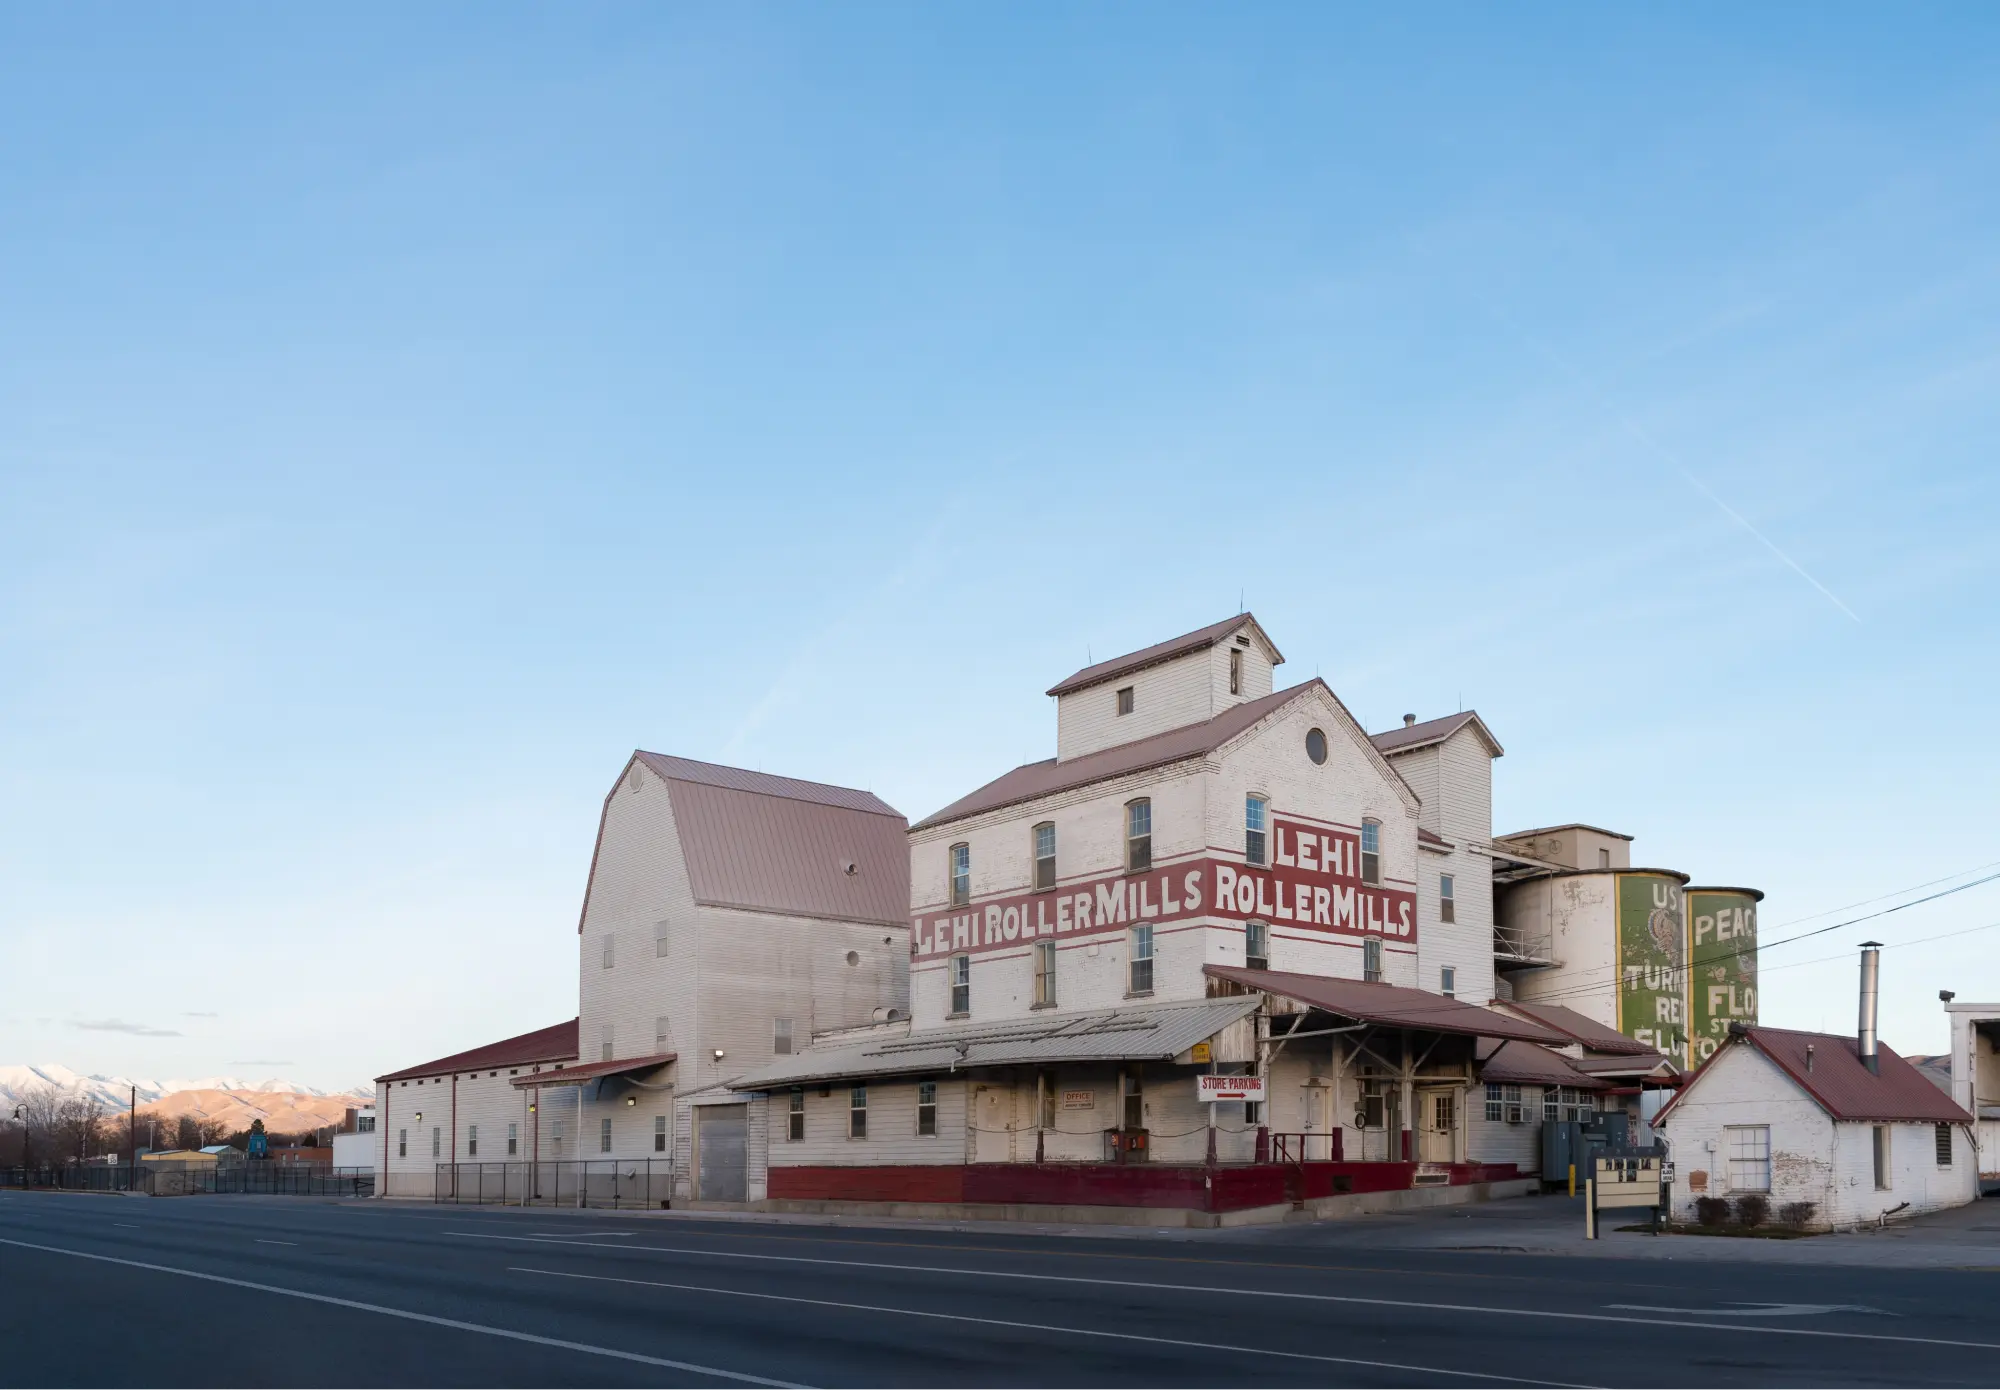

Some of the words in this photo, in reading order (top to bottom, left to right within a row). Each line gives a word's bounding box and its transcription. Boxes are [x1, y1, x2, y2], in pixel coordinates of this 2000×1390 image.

[1276, 827, 1355, 878] LEHI
[914, 912, 980, 955] LEHI
[1695, 907, 1757, 946] PEAC
[1656, 996, 1683, 1024] RE
[1708, 985, 1758, 1016] FLO
[1634, 1028, 1683, 1057] FLO
[1066, 1092, 1091, 1101] OFFICE
[1202, 1077, 1227, 1090] STORE
[1228, 1077, 1261, 1090] PARKING
